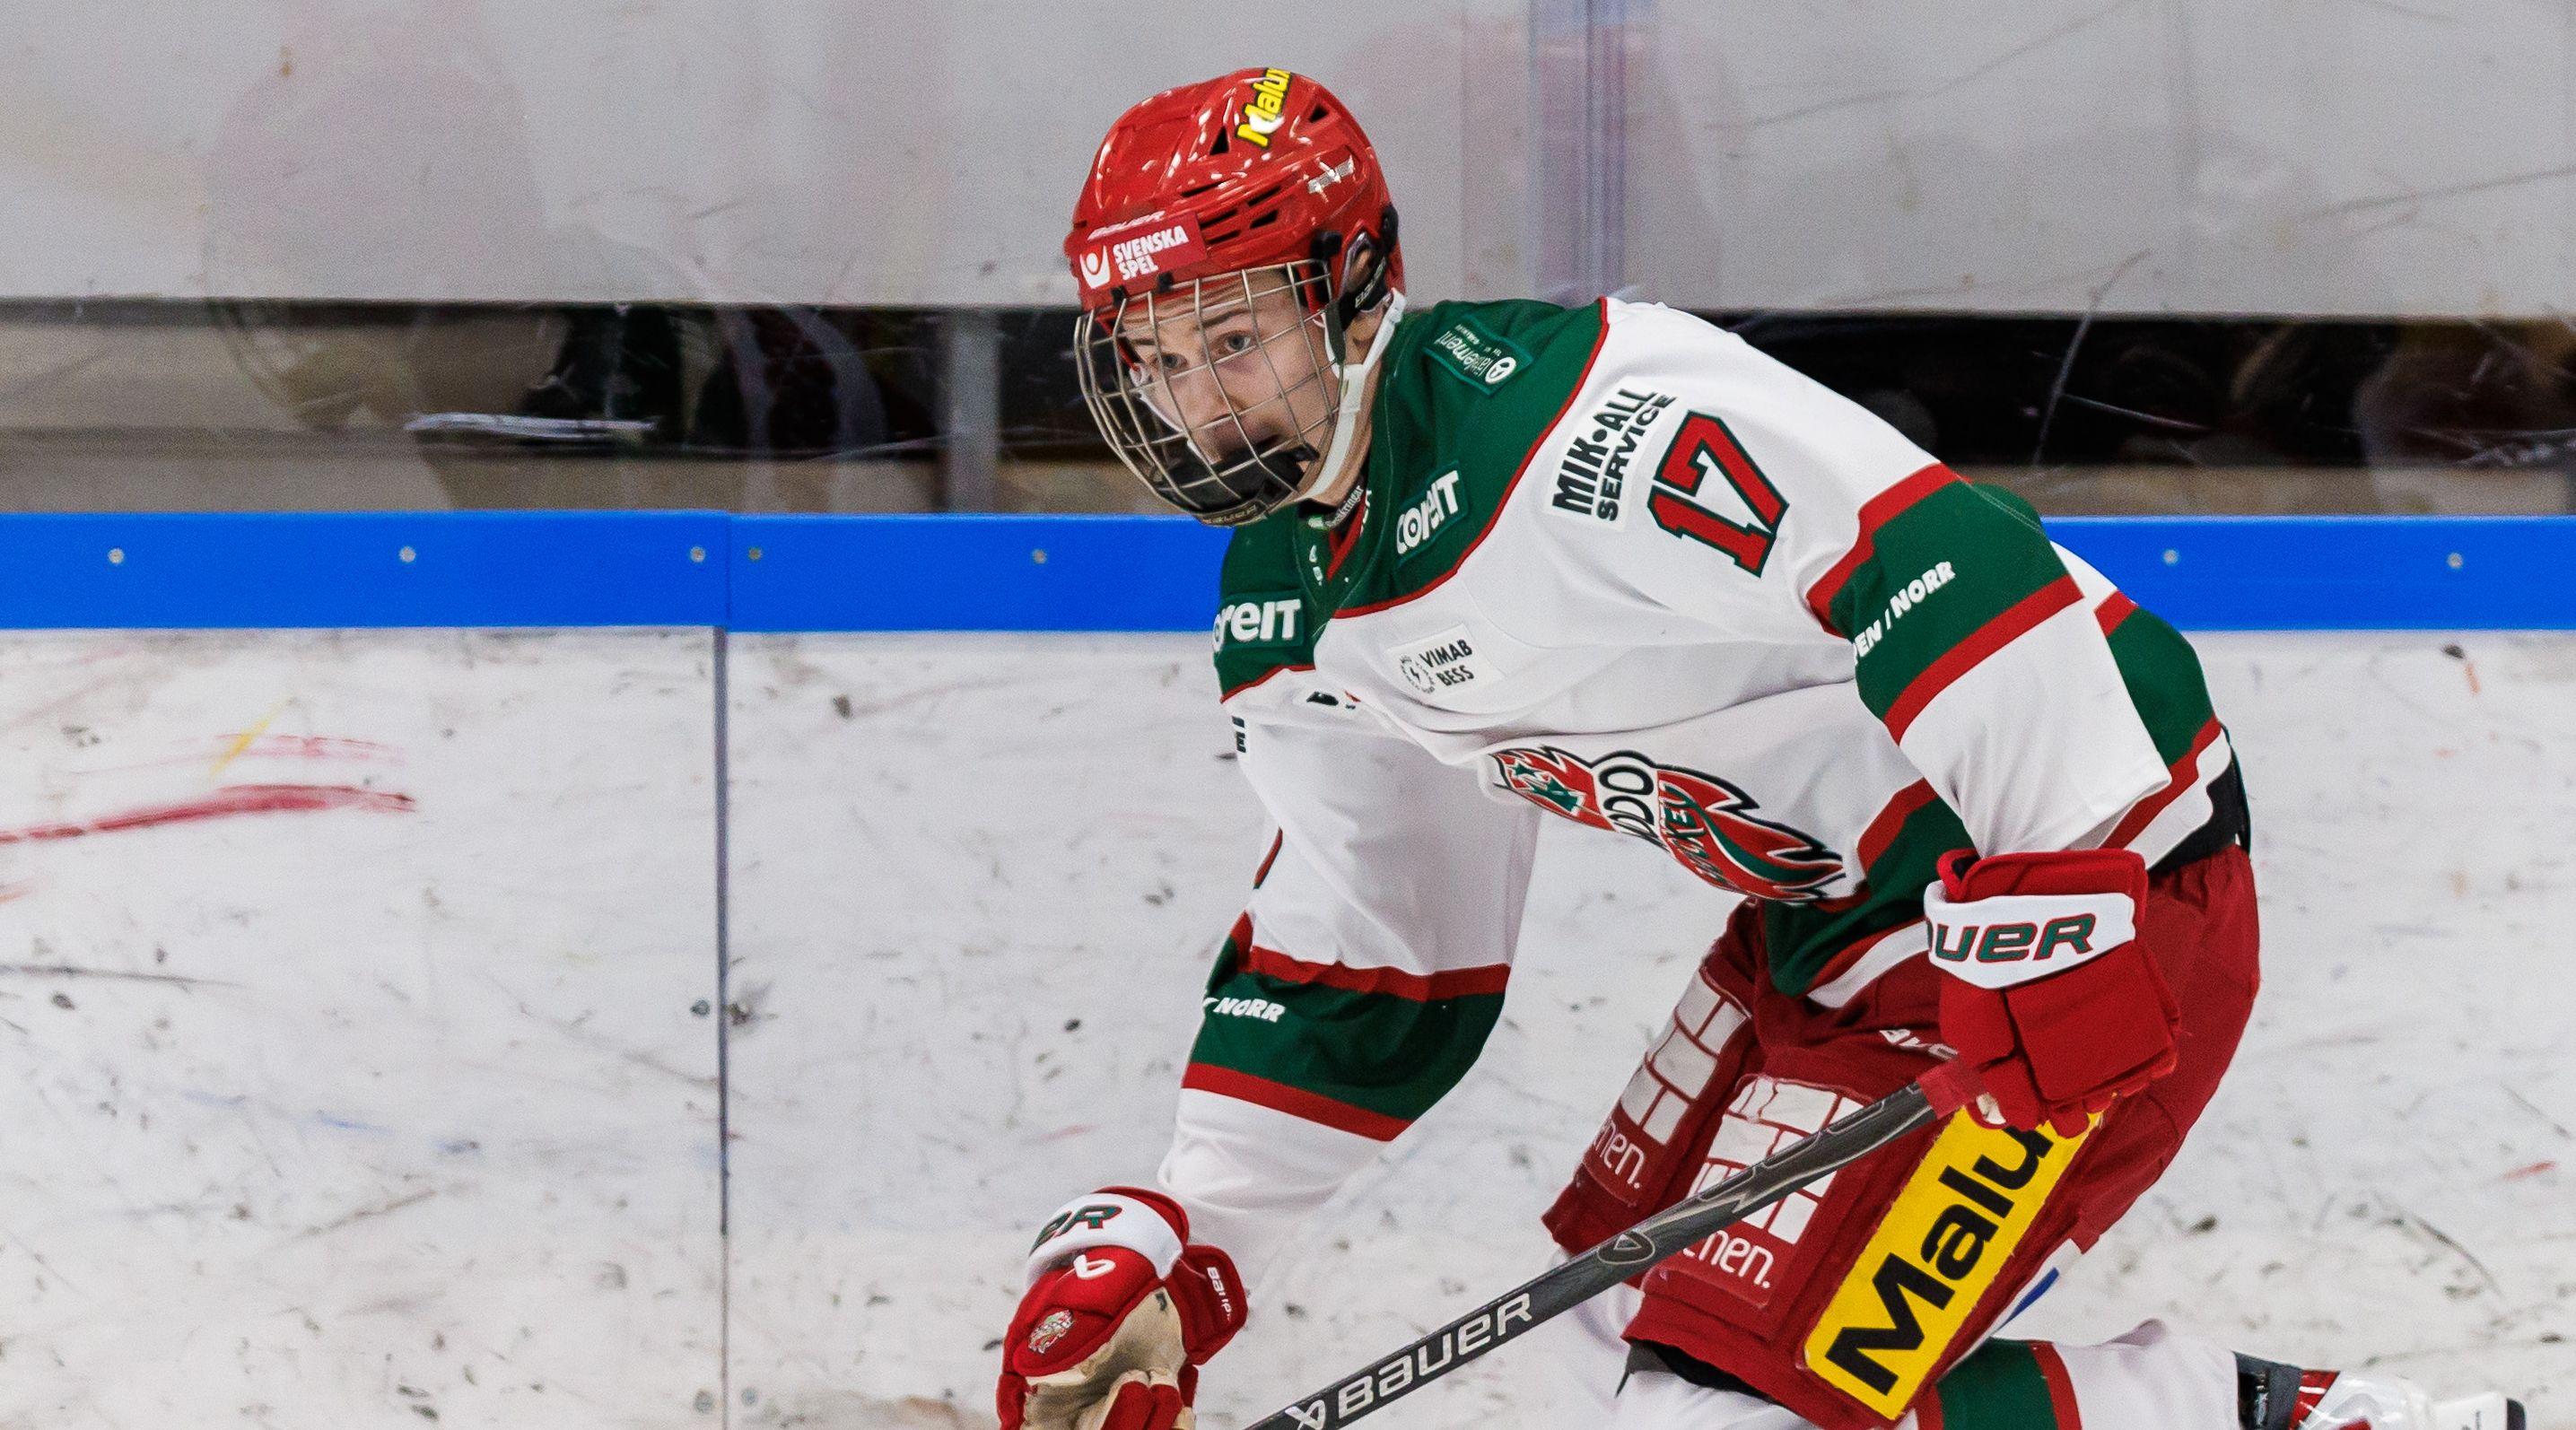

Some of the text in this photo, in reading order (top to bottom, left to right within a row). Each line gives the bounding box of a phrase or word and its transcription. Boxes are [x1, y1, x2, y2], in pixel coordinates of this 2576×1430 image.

[1113, 225, 1189, 264] SVENSKA
[1118, 254, 1159, 281] SPEL
[1596, 394, 1678, 521] SERVICE
[1647, 409, 1790, 579] 17
[1853, 620, 1882, 665] EN
[1890, 562, 1956, 619] NORR
[1419, 639, 1472, 667] VIMAB
[1436, 665, 1474, 686] BESS
[1927, 913, 2096, 963] UER
[1213, 998, 1286, 1023] NORR
